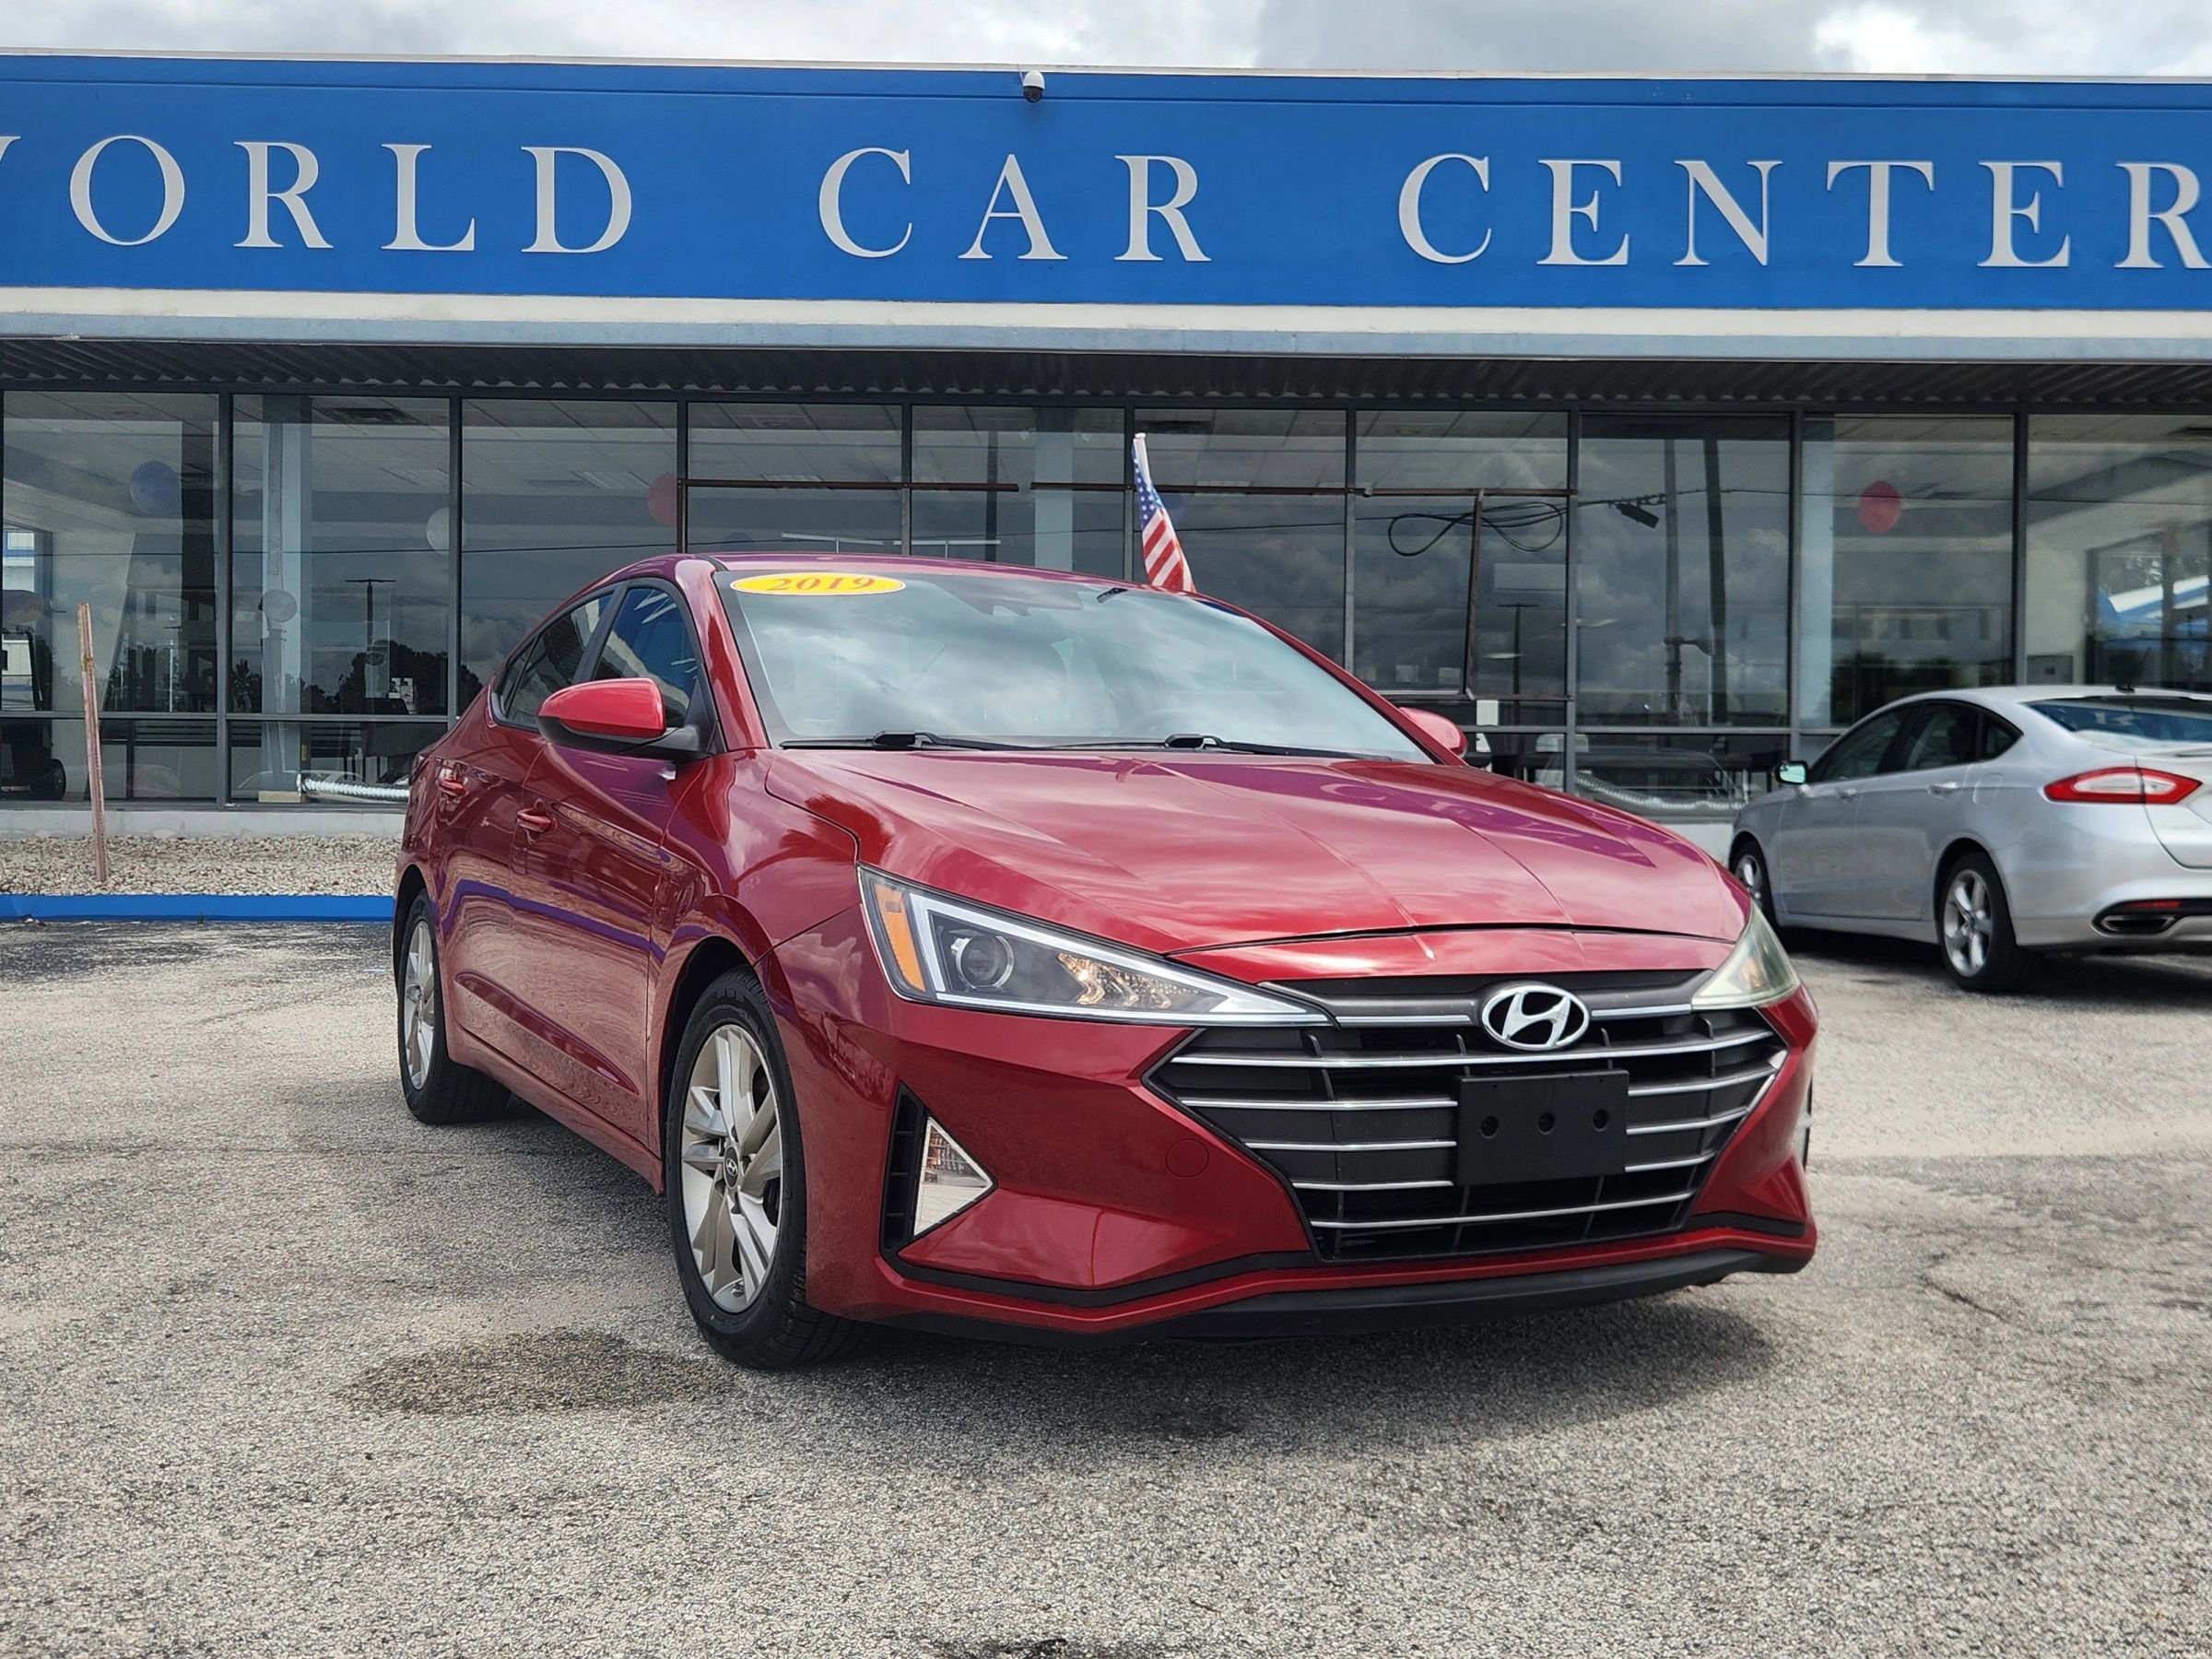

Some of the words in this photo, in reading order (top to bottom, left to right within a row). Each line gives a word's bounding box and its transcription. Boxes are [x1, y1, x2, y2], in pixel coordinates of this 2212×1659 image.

[0, 135, 632, 253] ORLD
[818, 147, 1211, 262] CAR
[1398, 154, 2212, 269] CENTER
[766, 577, 876, 591] 2019
